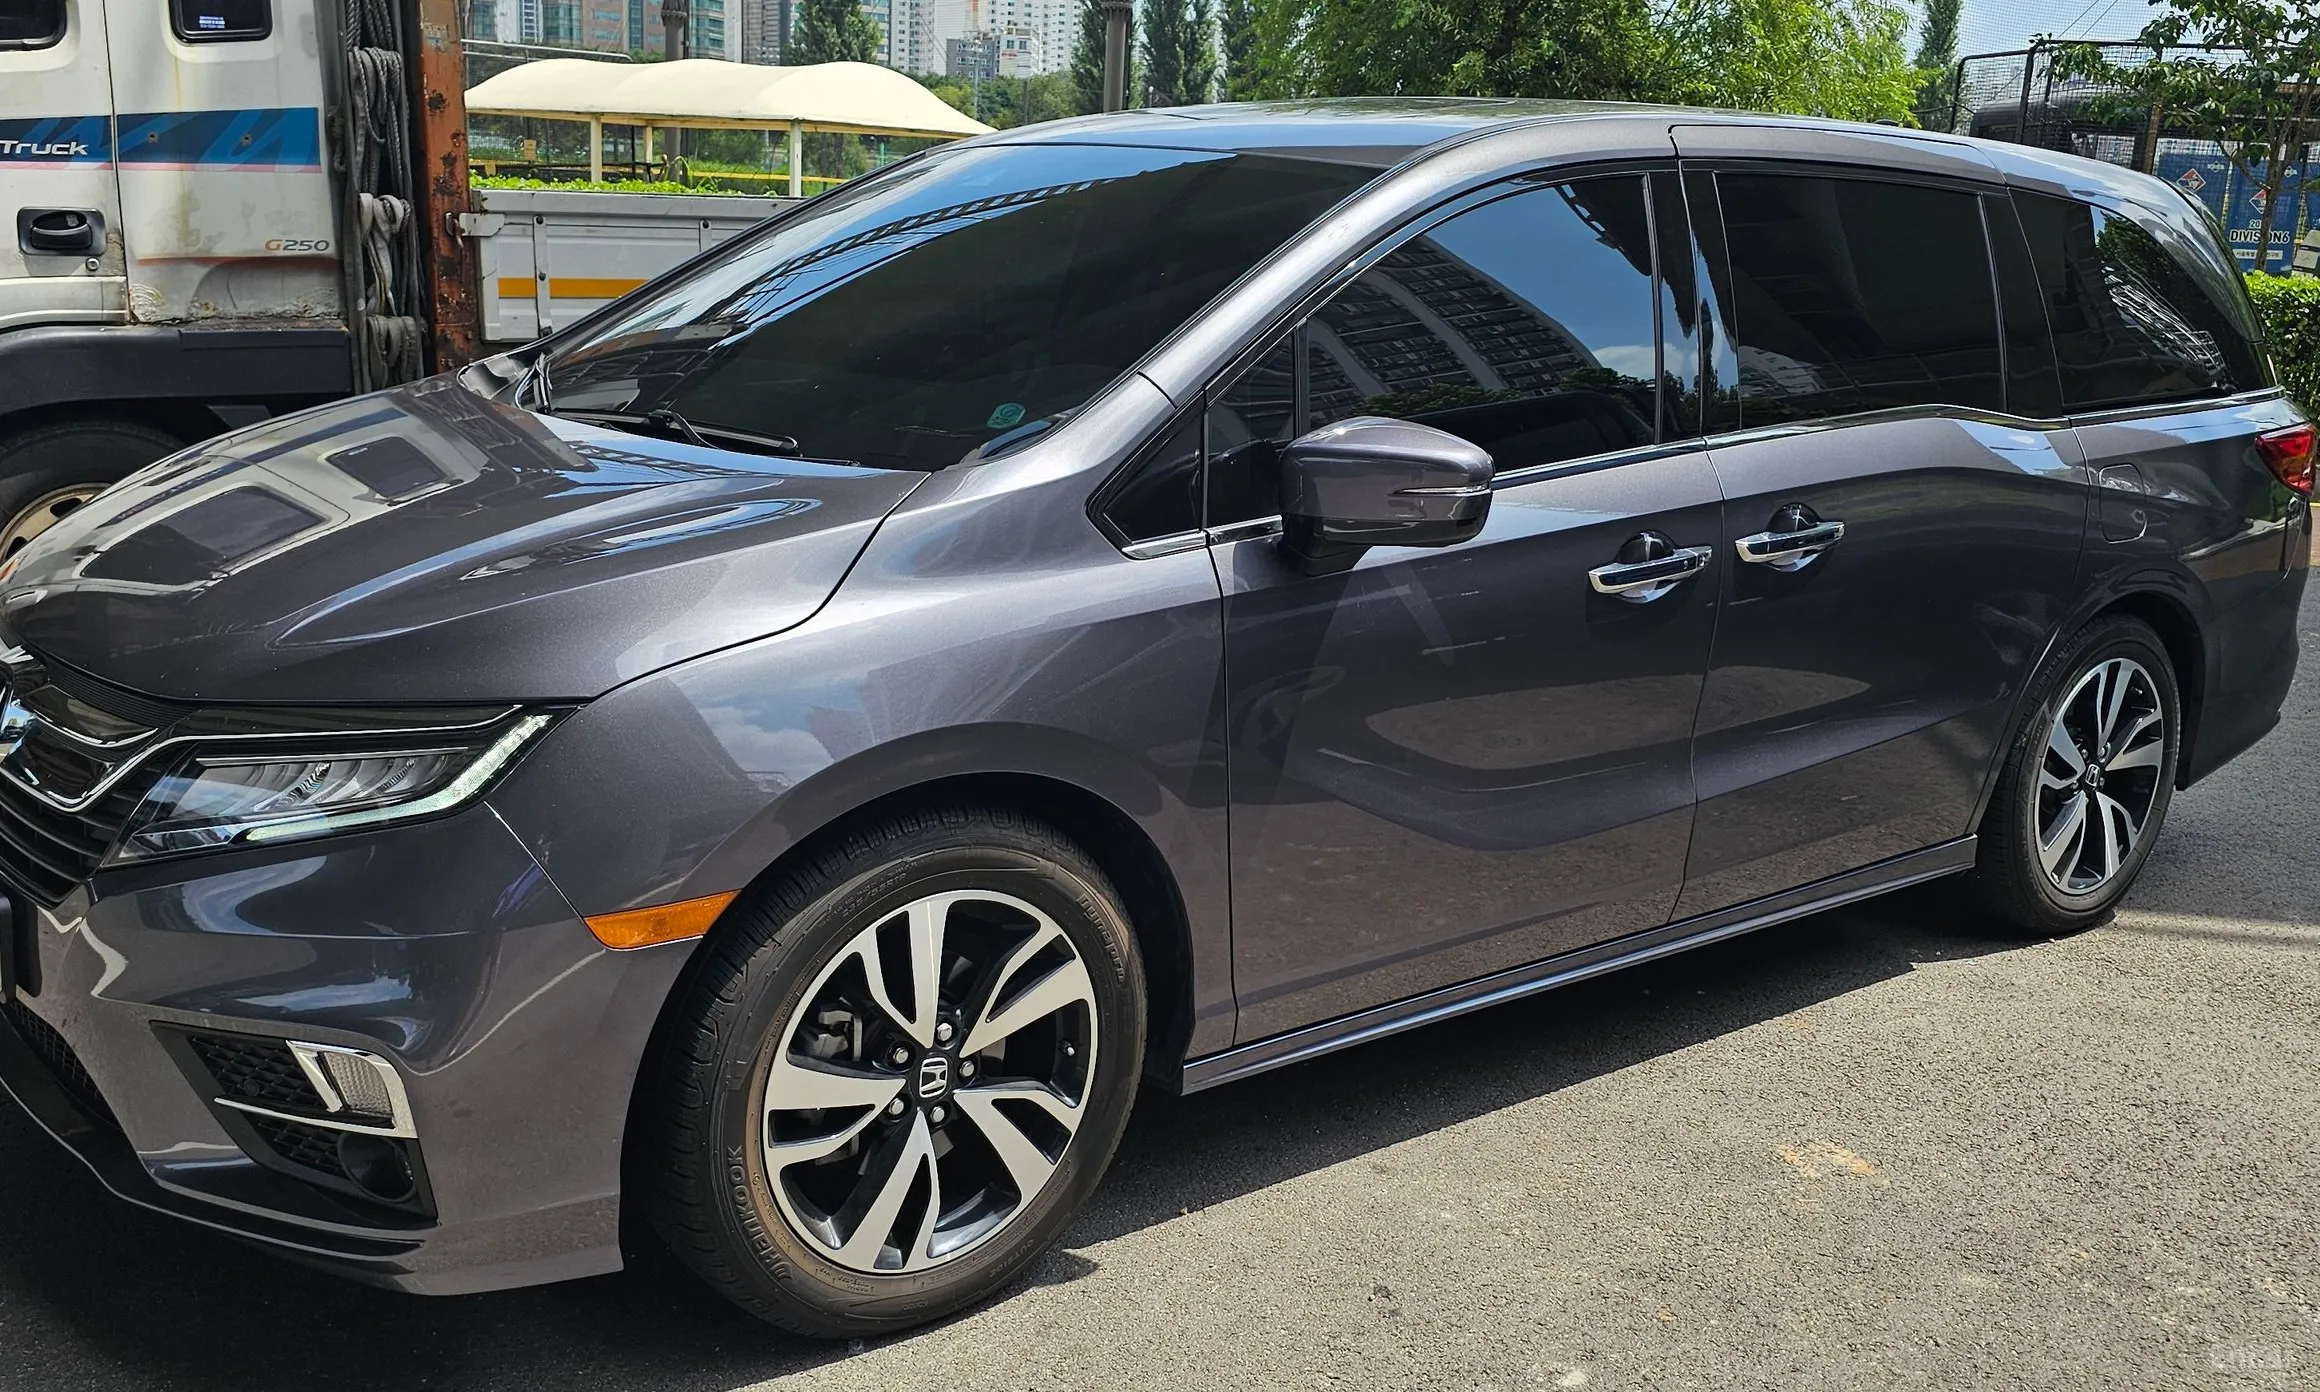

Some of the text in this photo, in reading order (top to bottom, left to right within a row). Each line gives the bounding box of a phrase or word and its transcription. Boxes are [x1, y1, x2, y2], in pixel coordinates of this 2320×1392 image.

[0, 140, 89, 156] Truck
[2229, 229, 2290, 244] DIVISN6
[264, 239, 330, 252] G250
